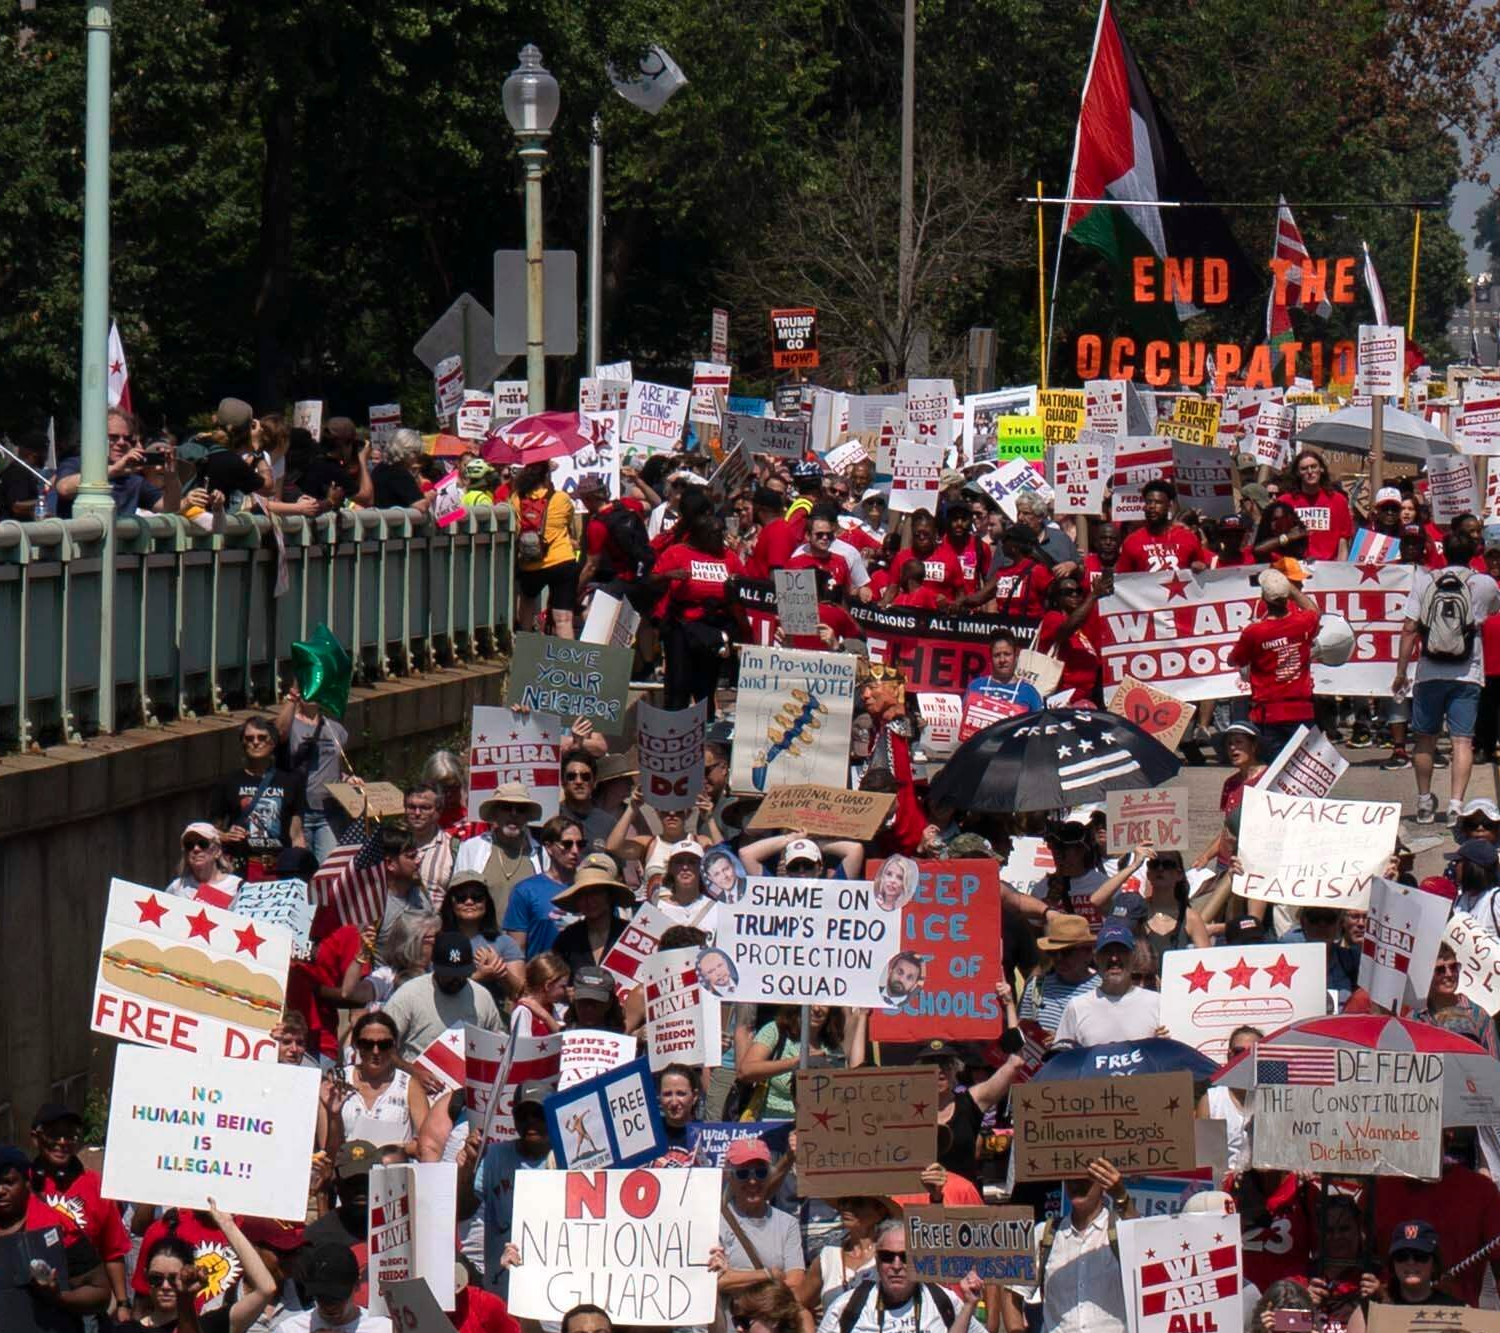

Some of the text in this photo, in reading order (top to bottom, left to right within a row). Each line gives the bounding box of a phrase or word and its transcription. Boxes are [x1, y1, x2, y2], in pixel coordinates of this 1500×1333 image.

[1133, 258, 1357, 306] END THE
[1077, 334, 1357, 392] OCCUPATIO
[1046, 410, 1079, 424] GUARD
[545, 645, 601, 671] LOVE
[536, 669, 602, 692] YOUR
[522, 687, 621, 722] NEIGHBOR
[752, 887, 870, 910] SHAME ON
[734, 917, 886, 943] TRUMP'S PEDO
[736, 947, 873, 970] PROTECTION
[761, 975, 849, 997] SQUAD
[1336, 1050, 1443, 1086] DEFEND
[191, 1086, 224, 1105] NO
[1261, 1087, 1441, 1117] THE CONSTITUTION
[132, 1106, 274, 1136] HUMAN BEING
[1292, 1121, 1323, 1140] NOT
[1346, 1121, 1423, 1143] Wannabe
[193, 1136, 213, 1152] IS
[1308, 1140, 1383, 1163] Dictator
[157, 1155, 233, 1178] ILLEGAL
[516, 1219, 707, 1270] NATIONAL
[547, 1272, 692, 1322] GUARD
